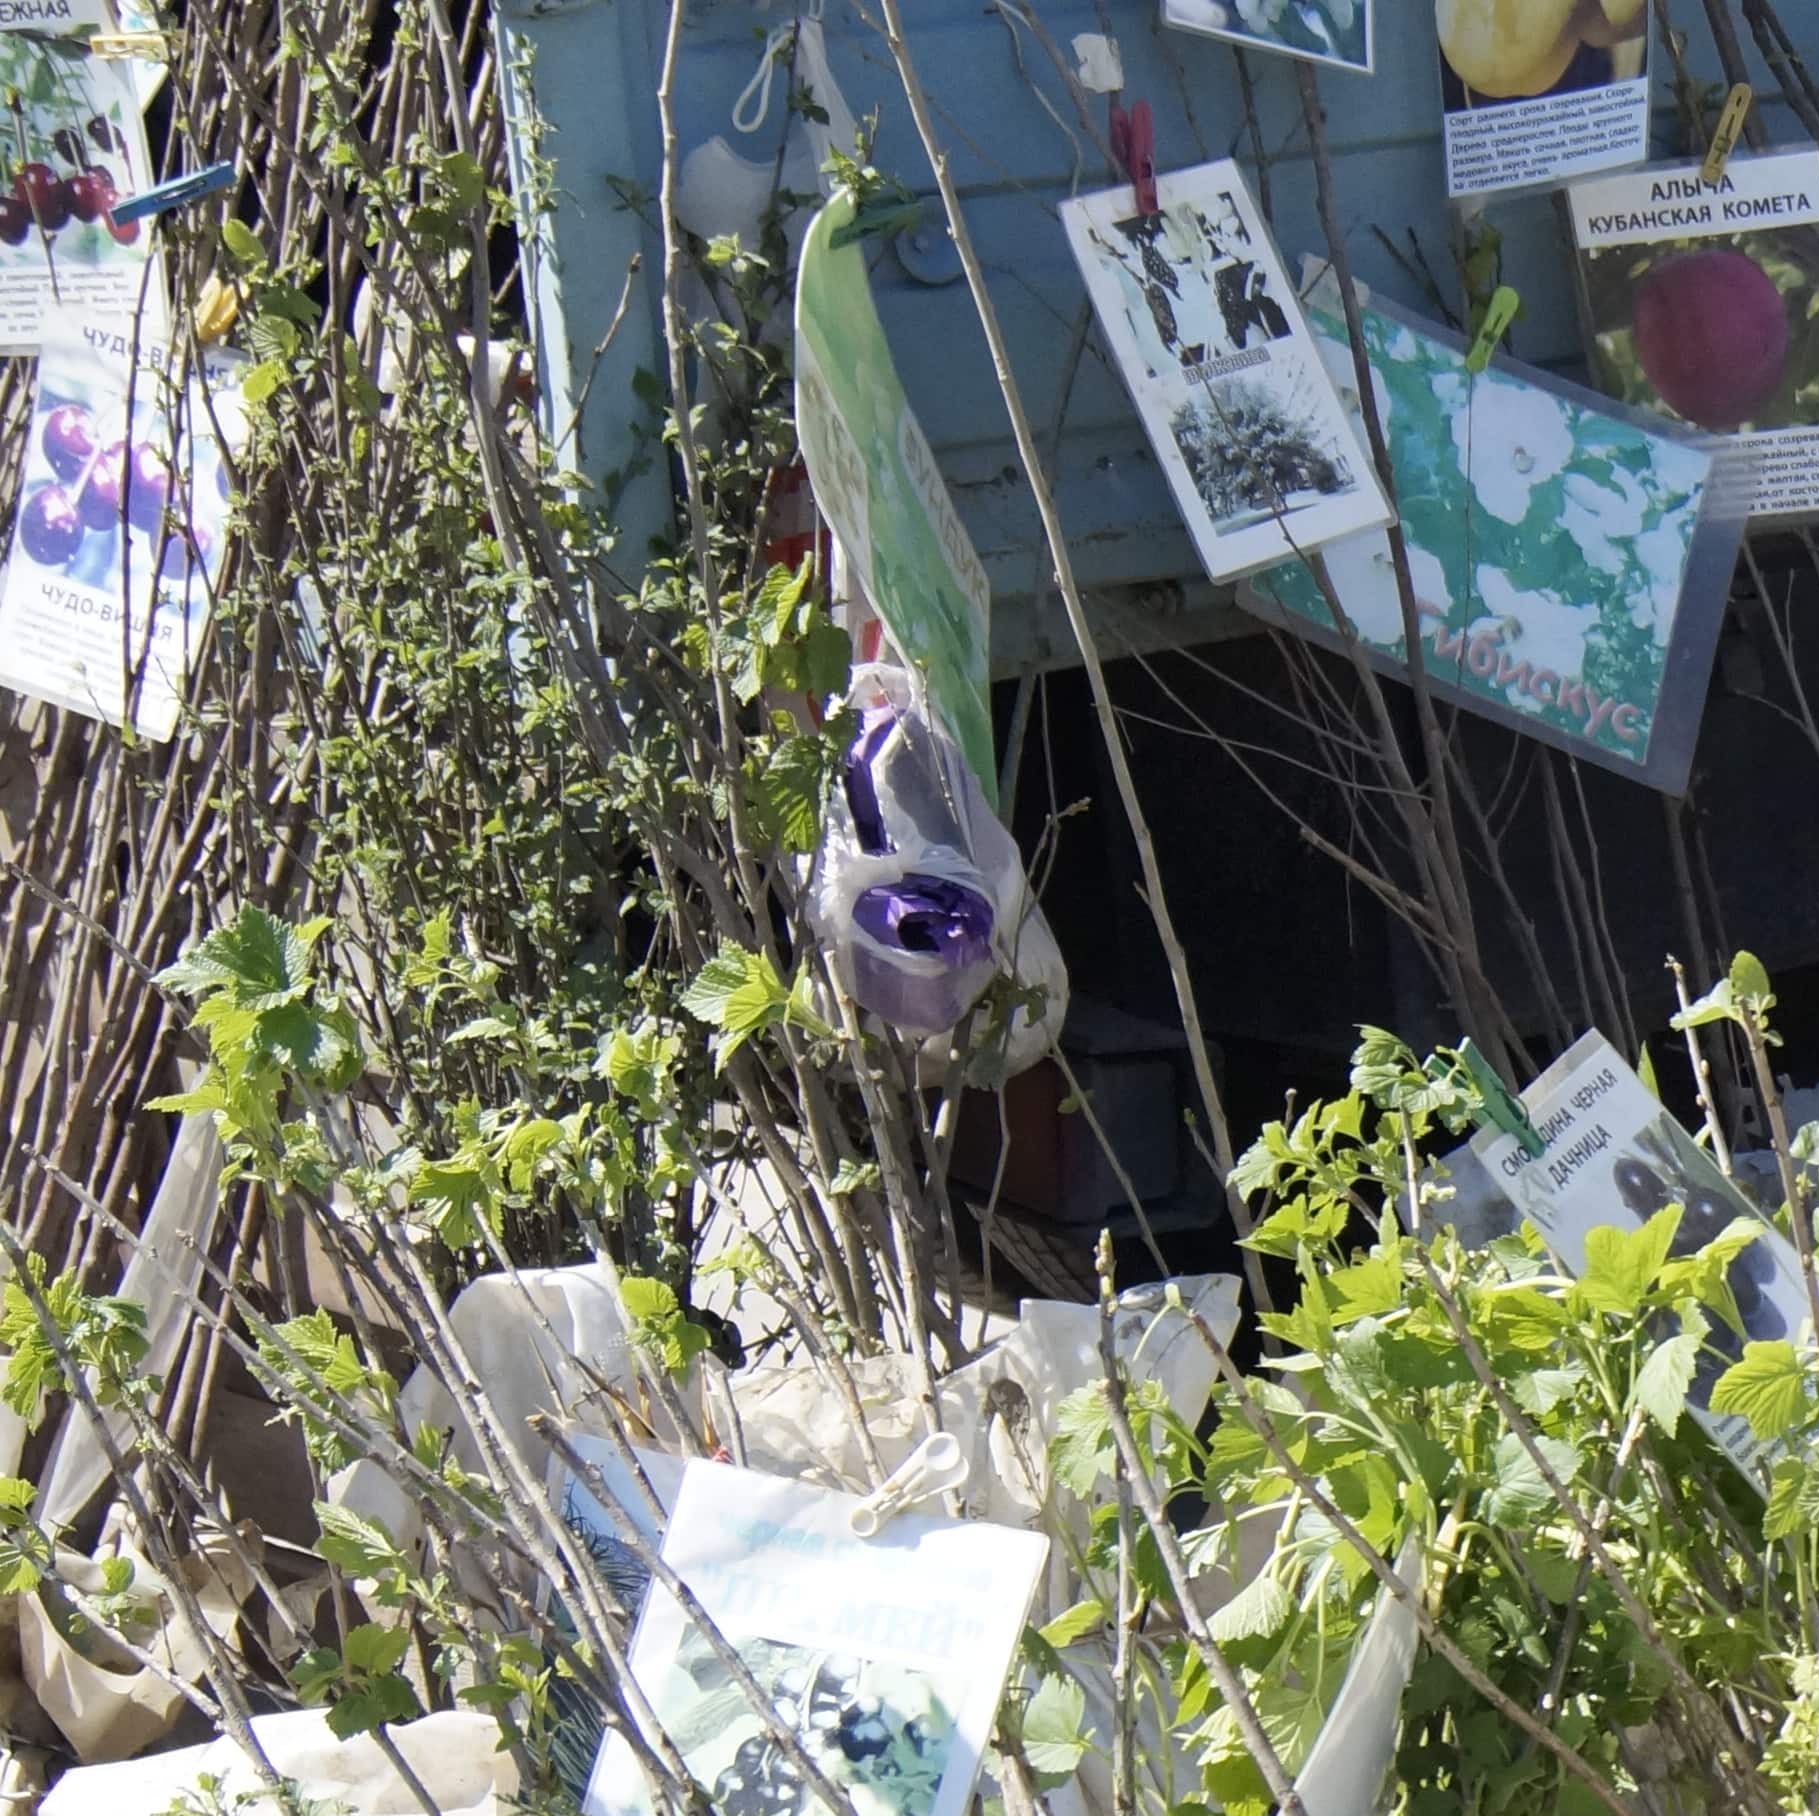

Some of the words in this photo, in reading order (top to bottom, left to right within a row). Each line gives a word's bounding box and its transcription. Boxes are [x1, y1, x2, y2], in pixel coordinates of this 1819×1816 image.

[1651, 174, 1735, 201] АЛЫЧА
[1588, 205, 1712, 235] КУБАНСКАЯ
[1723, 193, 1812, 220] КОМЕТА
[1570, 1068, 1618, 1112] ЧЕРНАЯ
[1548, 1124, 1613, 1190] ДАЧНИЦА
